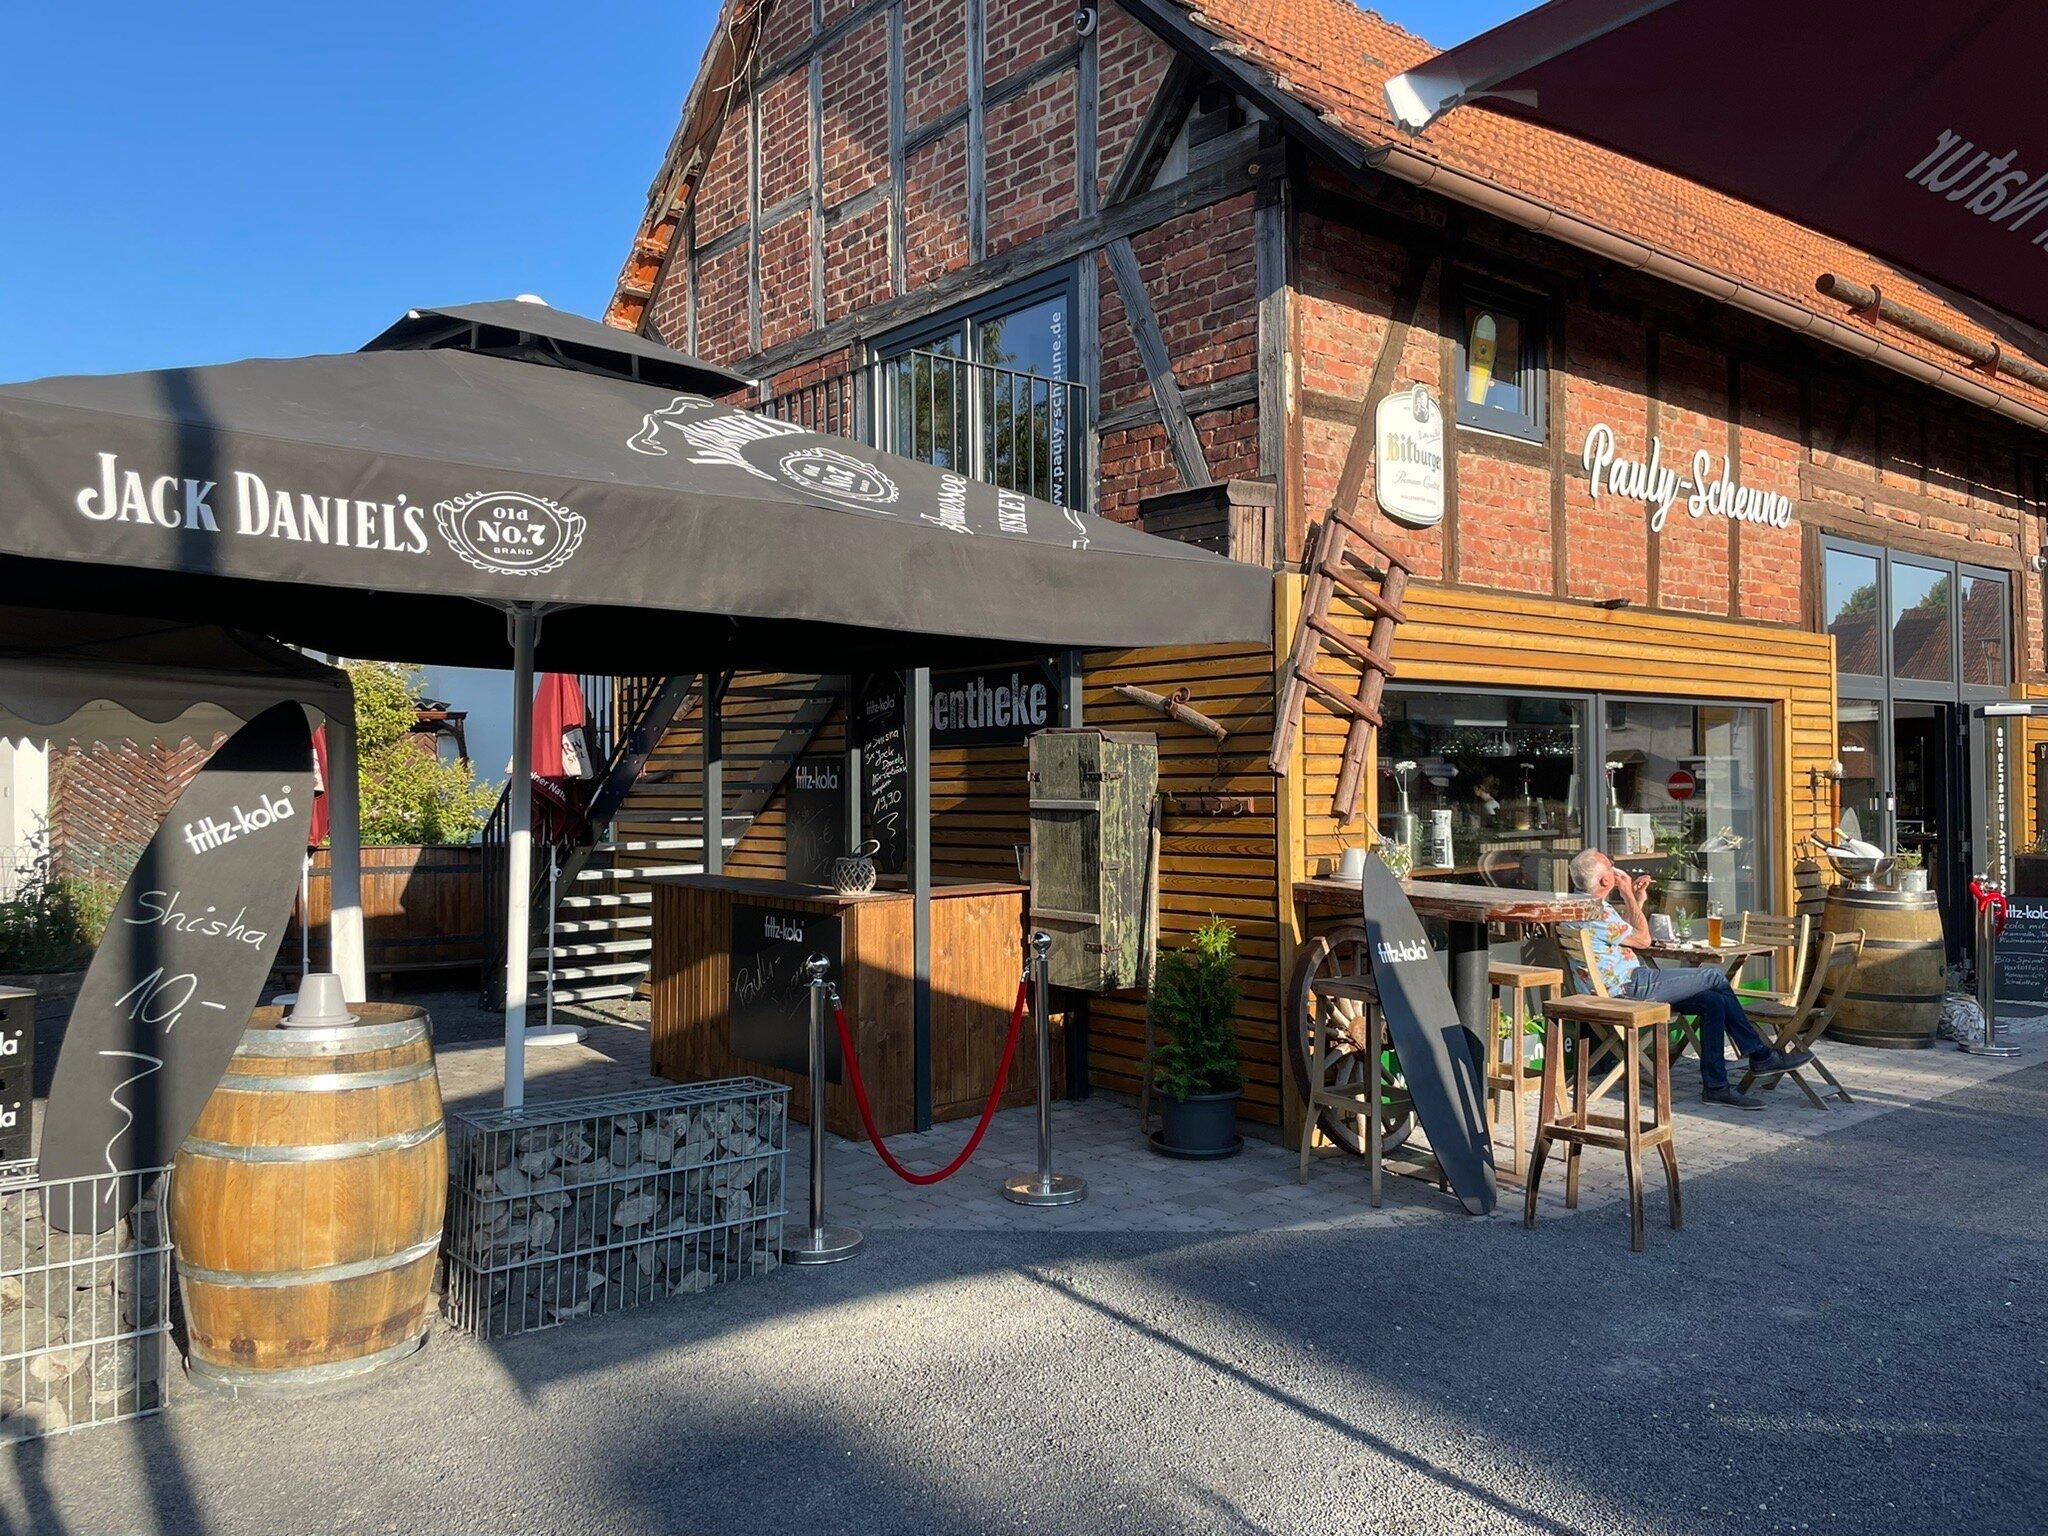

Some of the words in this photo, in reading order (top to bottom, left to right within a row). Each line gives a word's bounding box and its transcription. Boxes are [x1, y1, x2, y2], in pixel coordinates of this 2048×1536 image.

[1386, 432, 1442, 473] Bitburger
[1583, 422, 1793, 533] Pauly-Scheune
[76, 452, 221, 534] JACK
[234, 471, 429, 554] DANIEL'S
[493, 507, 529, 521] Old
[476, 520, 546, 547] No.7
[493, 546, 534, 556] BRAND
[929, 673, 1047, 731] entheke
[796, 766, 838, 790] fritz-kola
[184, 792, 295, 856] fritz-kola
[123, 890, 267, 951] Shisha
[764, 915, 803, 942] fritz-kola
[1378, 939, 1428, 963] fritz-kola
